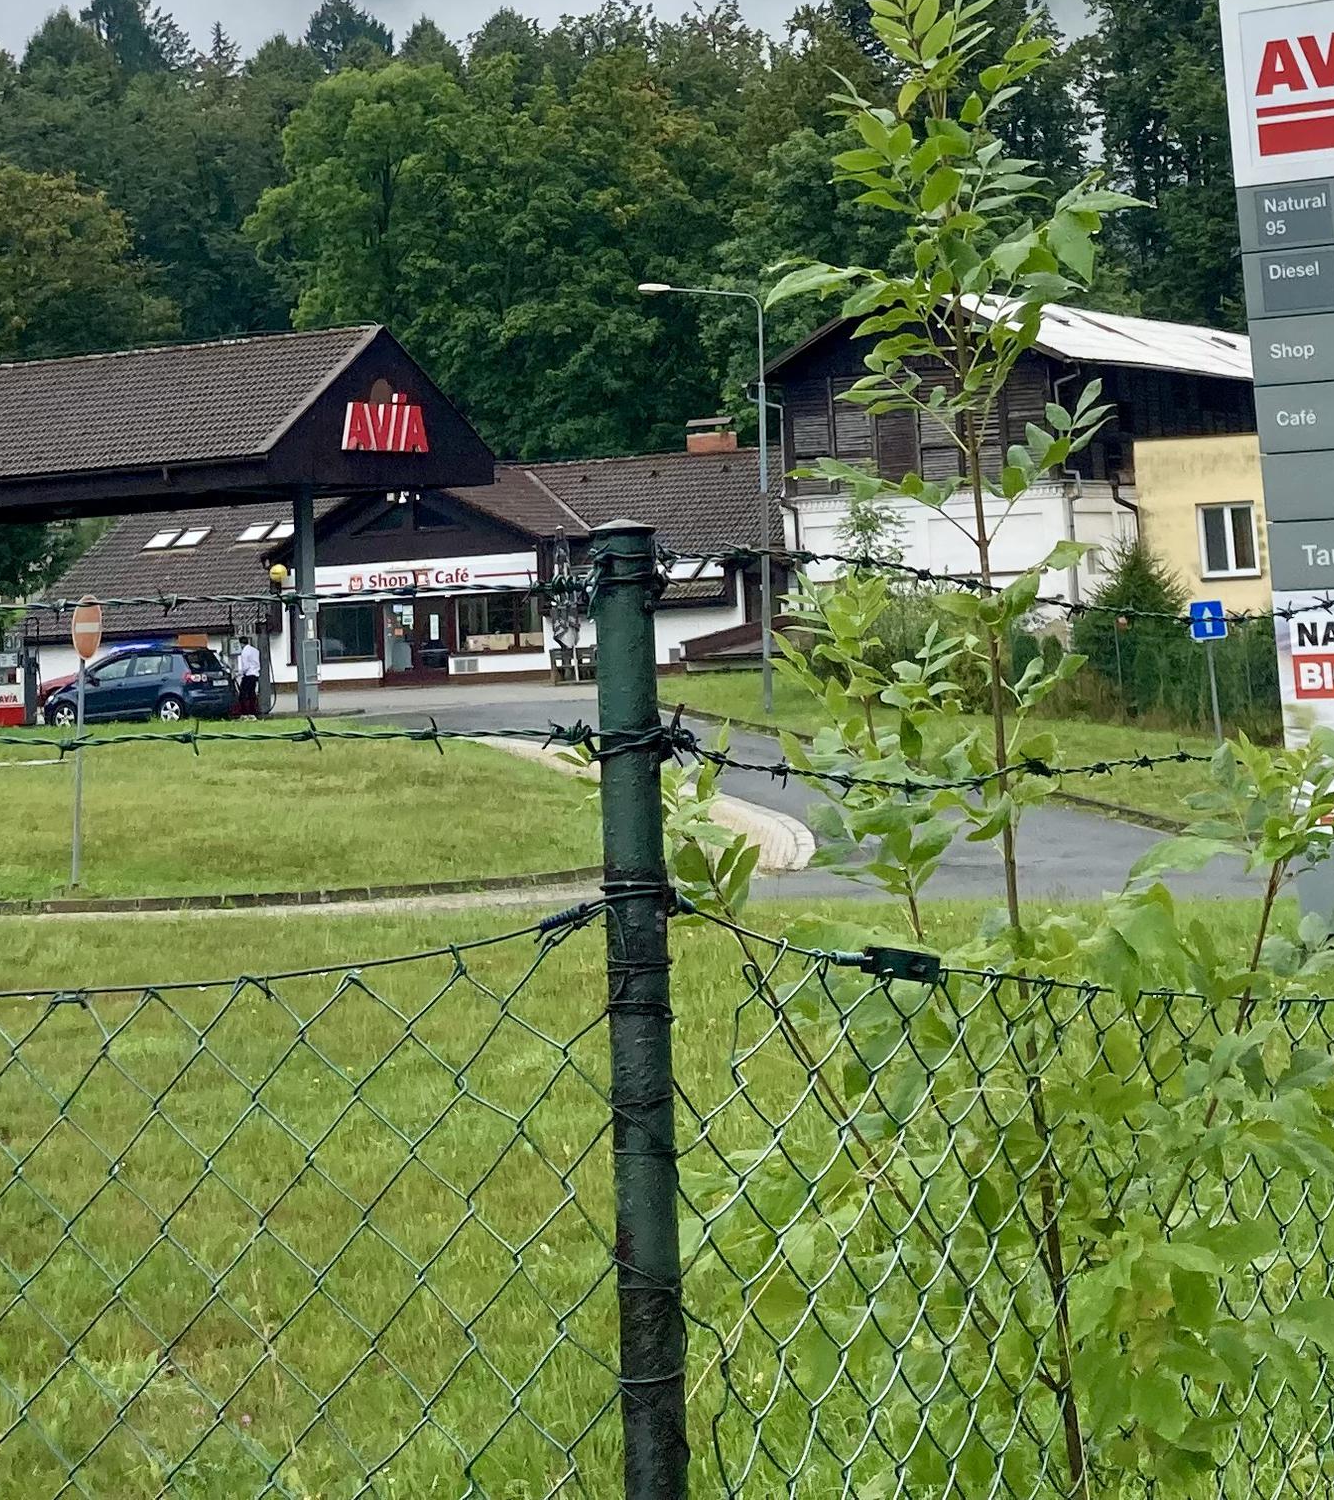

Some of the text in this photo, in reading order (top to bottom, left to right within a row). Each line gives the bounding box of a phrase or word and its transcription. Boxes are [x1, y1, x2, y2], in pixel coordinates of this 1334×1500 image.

[1264, 192, 1327, 213] Natural
[1265, 220, 1287, 236] 95
[1269, 261, 1320, 280] Diesel
[1270, 343, 1315, 360] Shop
[341, 392, 429, 453] AVIA
[1276, 409, 1317, 426] Café
[369, 567, 470, 589] Shop Café
